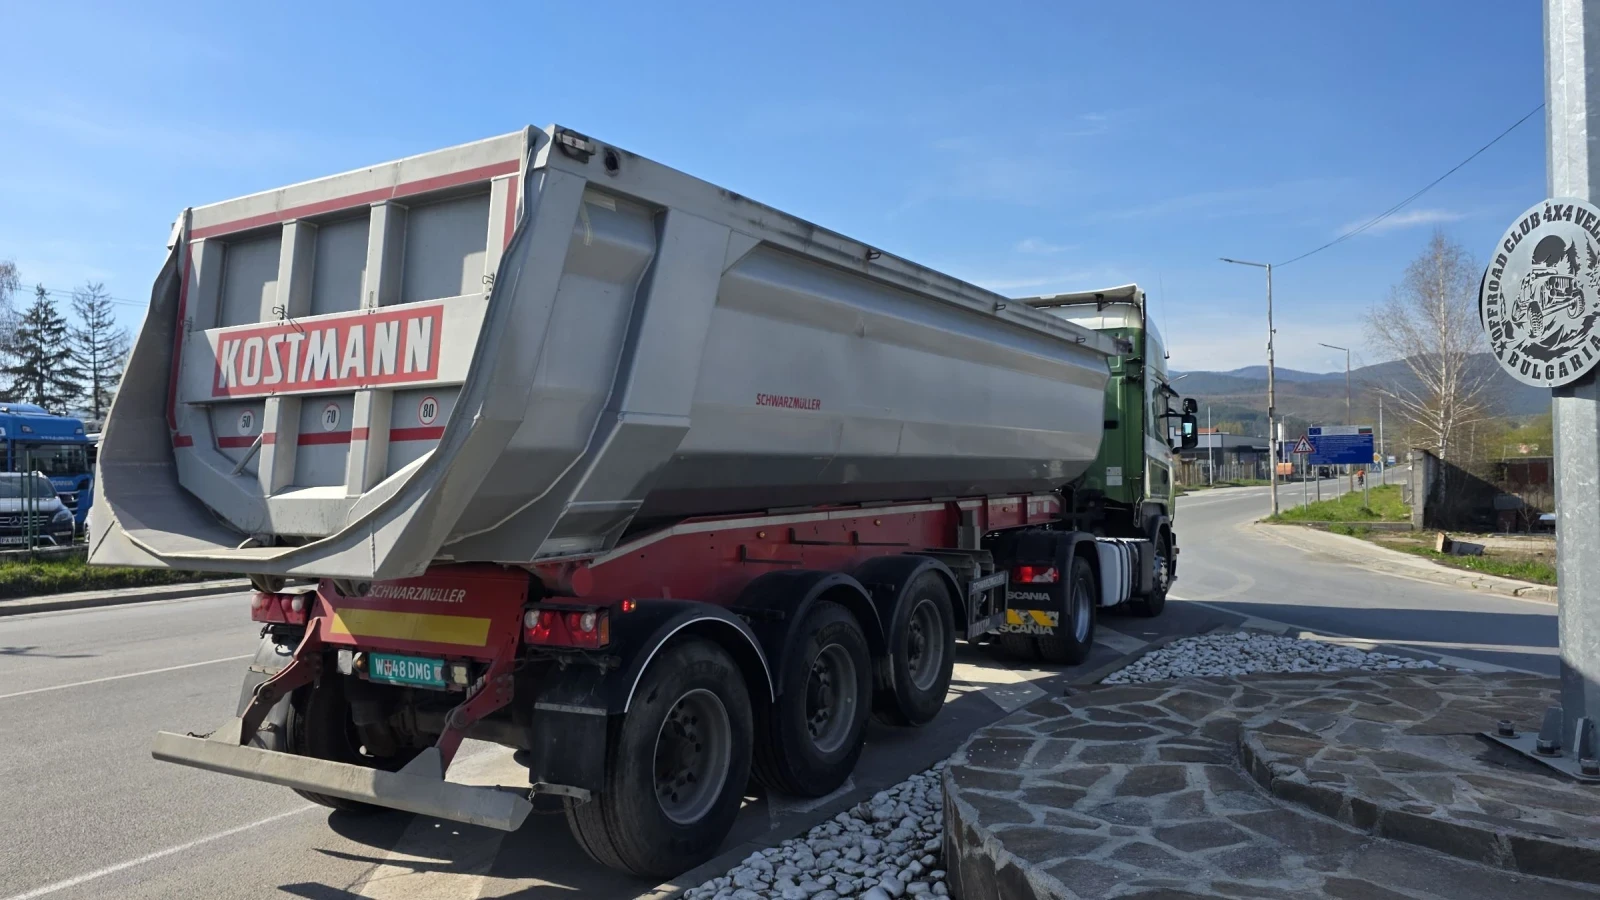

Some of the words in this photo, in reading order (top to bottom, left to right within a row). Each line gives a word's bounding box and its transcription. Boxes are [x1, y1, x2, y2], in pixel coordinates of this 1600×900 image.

[1487, 253, 1508, 341] OFFROAD
[1503, 211, 1541, 254] CLUB
[1543, 204, 1574, 222] 4X4
[1574, 206, 1600, 245] VEL
[218, 315, 432, 389] KOSTMANN
[1507, 334, 1600, 380] BULGARIA
[756, 393, 821, 410] SCHWARZMÜLLER
[326, 409, 336, 424] 70
[422, 403, 434, 418] 80
[241, 415, 251, 429] 50
[367, 585, 466, 602] SCHWARZMÜLLER
[1007, 591, 1051, 601] SCANIA
[999, 623, 1054, 636] SCANIA
[375, 657, 384, 675] W
[407, 661, 431, 681] DMG
